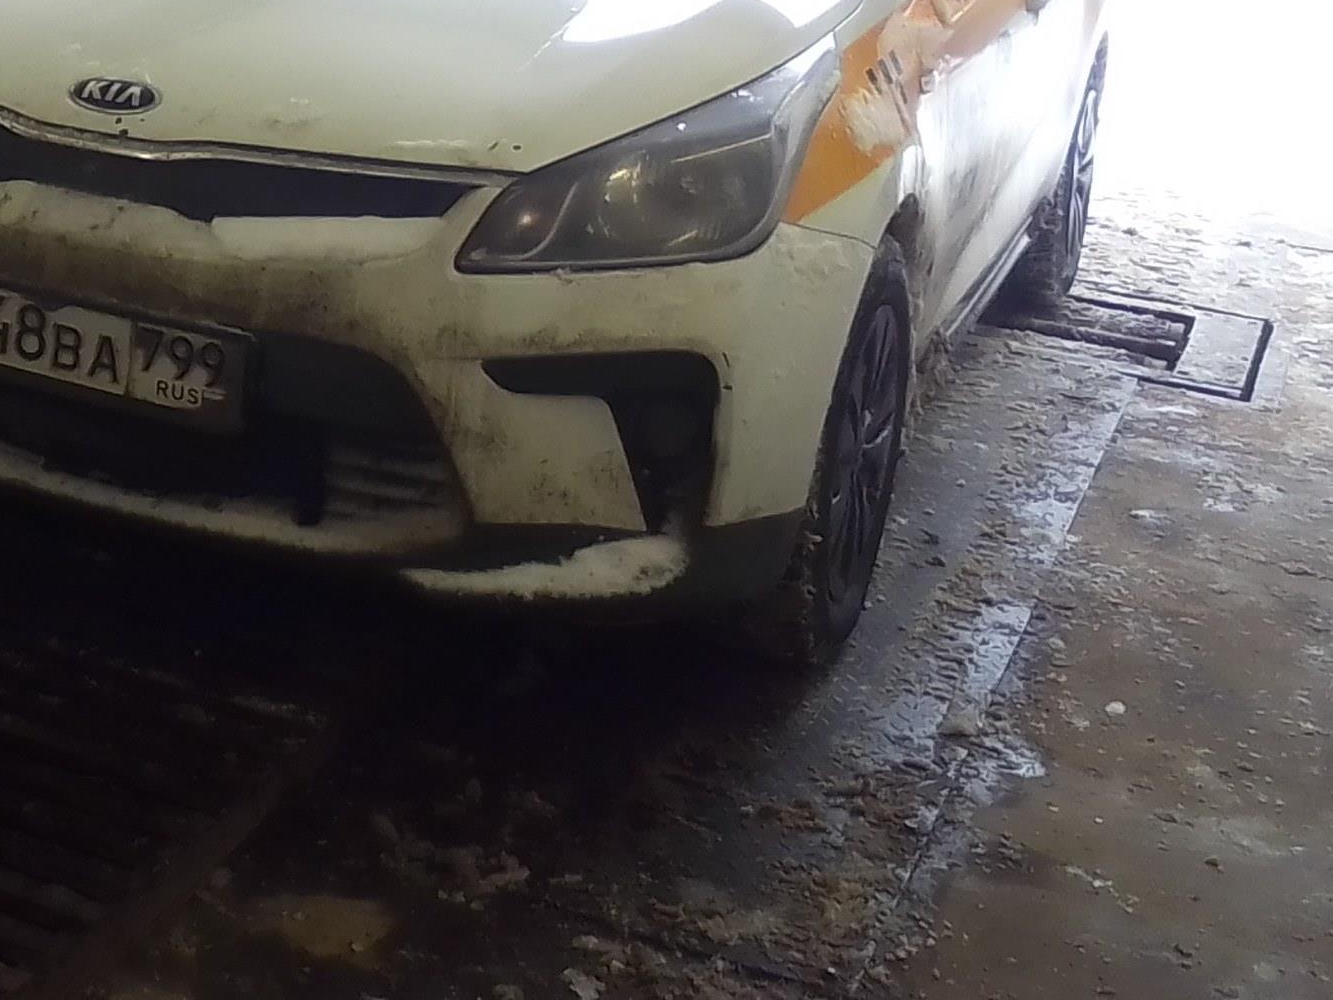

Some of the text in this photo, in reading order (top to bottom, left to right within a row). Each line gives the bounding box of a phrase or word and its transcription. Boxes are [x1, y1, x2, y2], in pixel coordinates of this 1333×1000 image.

[80, 80, 141, 107] KIA
[136, 327, 226, 388] 799
[155, 379, 199, 405] RUS
